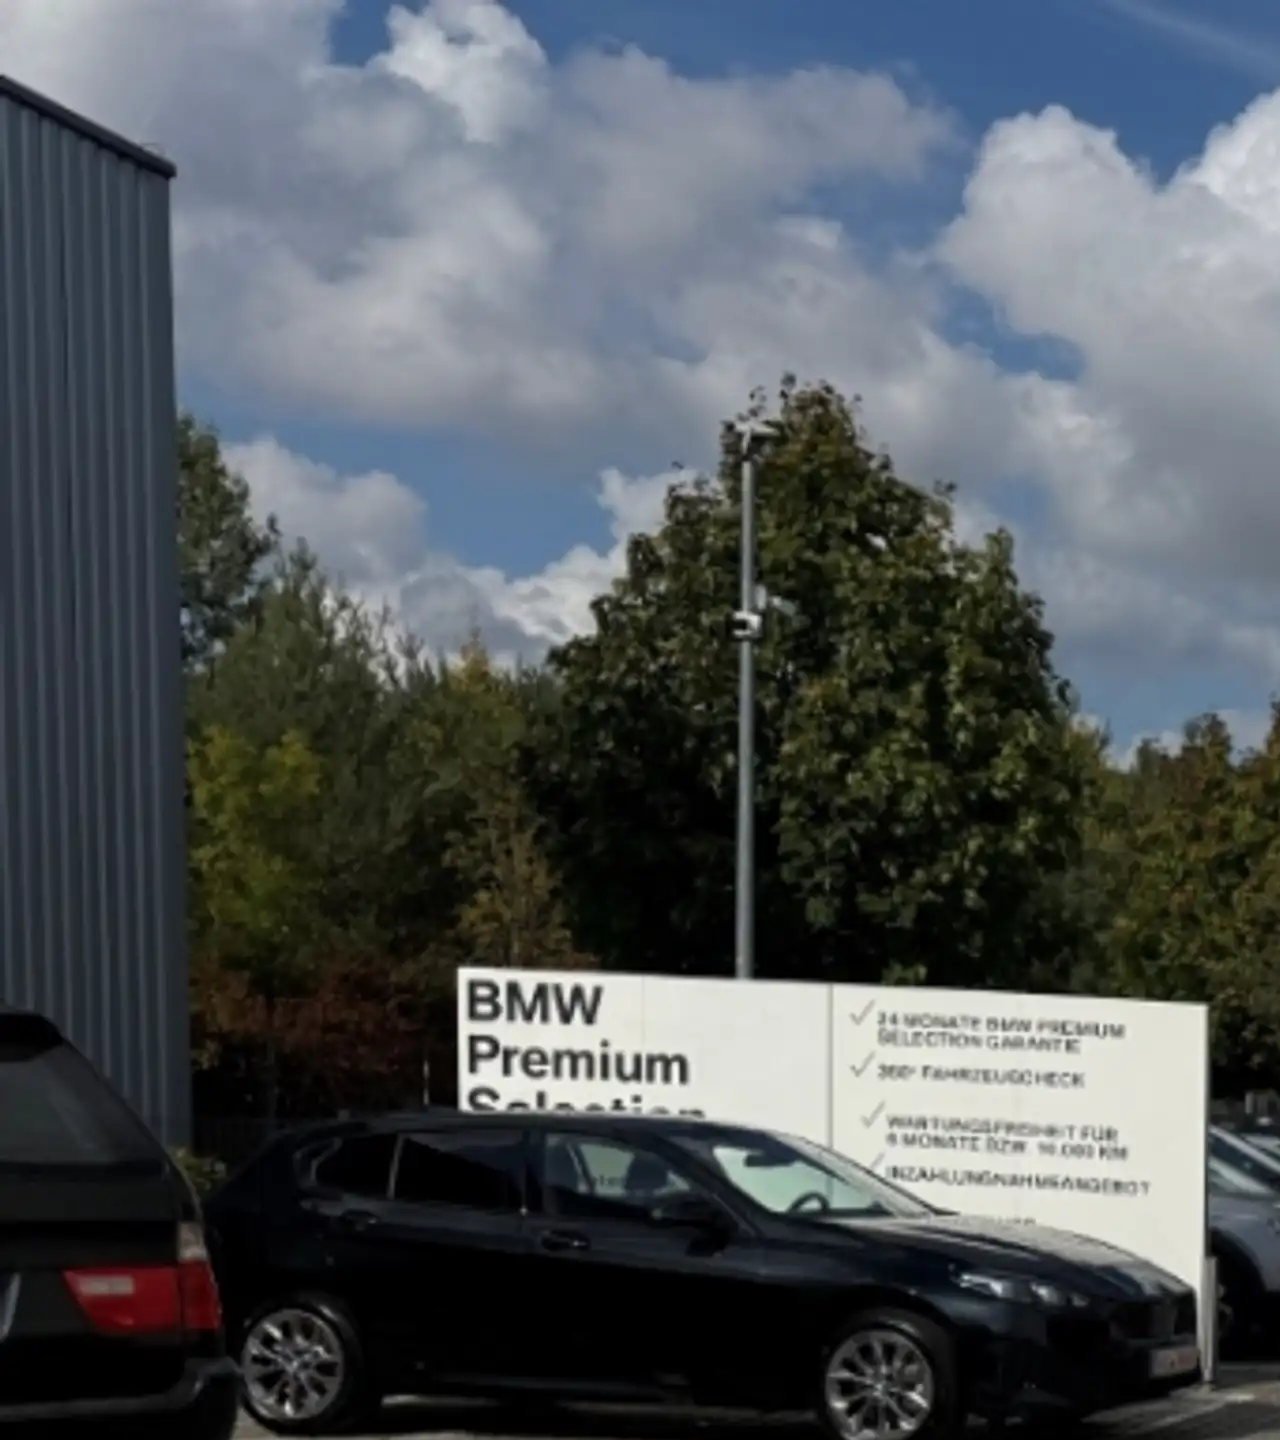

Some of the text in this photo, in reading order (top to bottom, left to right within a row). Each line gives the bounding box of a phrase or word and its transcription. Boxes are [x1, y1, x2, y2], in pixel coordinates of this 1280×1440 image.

[467, 979, 603, 1025] BMW
[904, 1011, 980, 1033] MONATE
[986, 1016, 1032, 1033] BMW
[1036, 1019, 1126, 1039] PREMIUM
[467, 1034, 690, 1084] Premium
